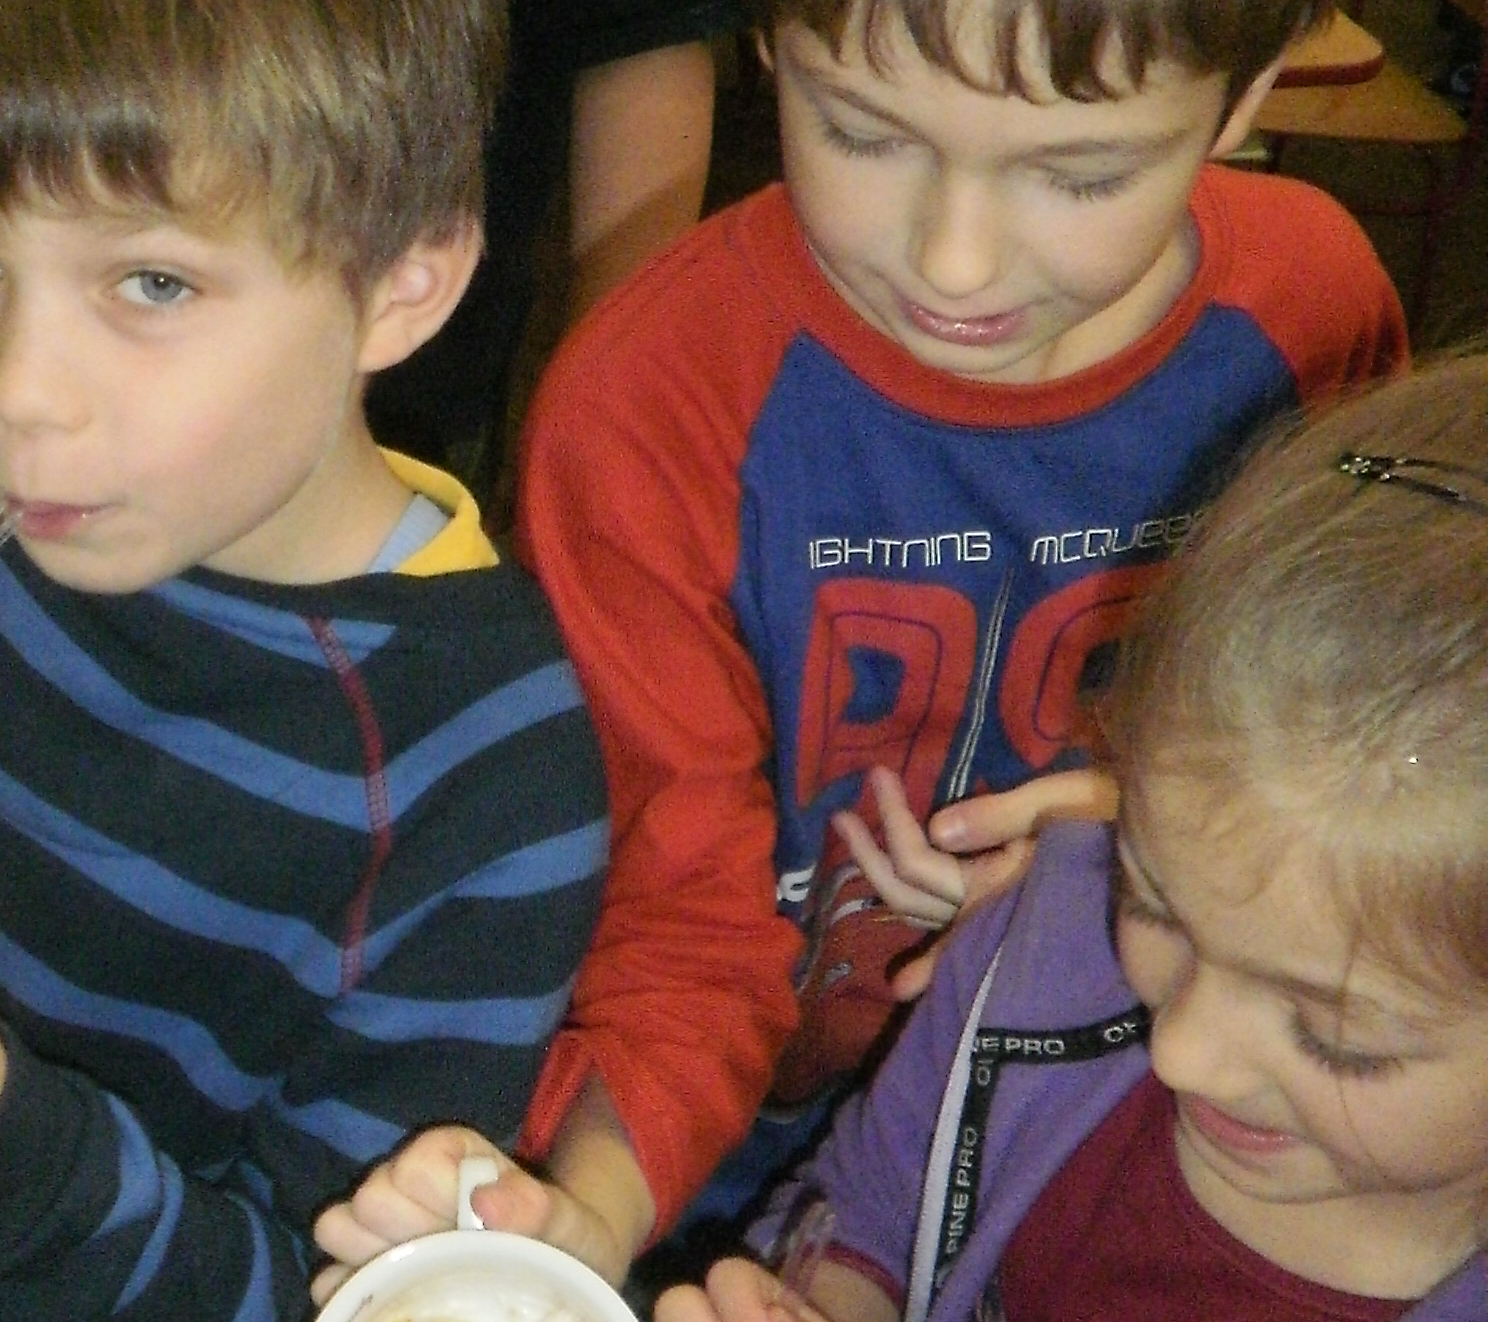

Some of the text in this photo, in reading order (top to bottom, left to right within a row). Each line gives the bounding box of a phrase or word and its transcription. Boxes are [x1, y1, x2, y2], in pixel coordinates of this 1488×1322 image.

[1030, 510, 1204, 565] MCQUEE
[1005, 1037, 1065, 1056] PRO
[956, 1127, 979, 1187] PRO
